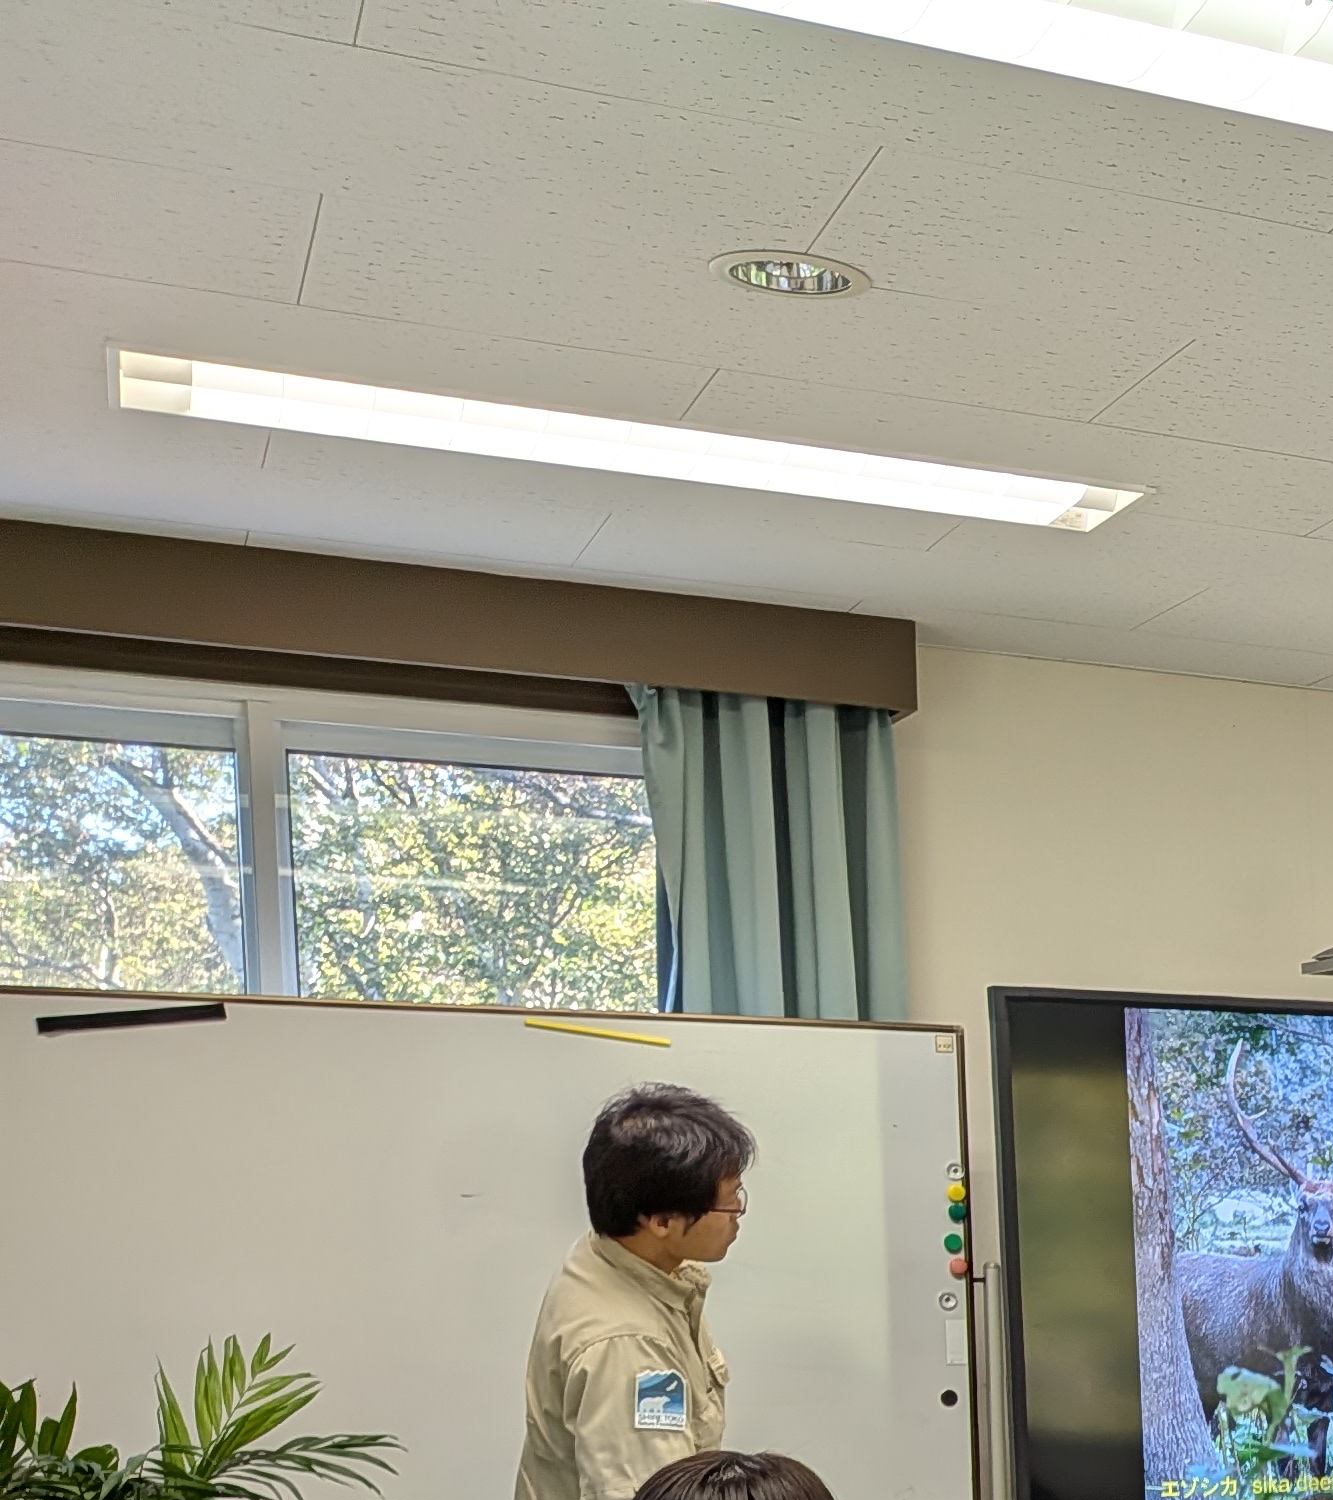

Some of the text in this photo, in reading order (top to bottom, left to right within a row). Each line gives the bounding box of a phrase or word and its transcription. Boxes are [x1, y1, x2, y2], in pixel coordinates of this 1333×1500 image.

[1161, 1475, 1238, 1498] エゾシカ
[1252, 1476, 1290, 1495] sika
